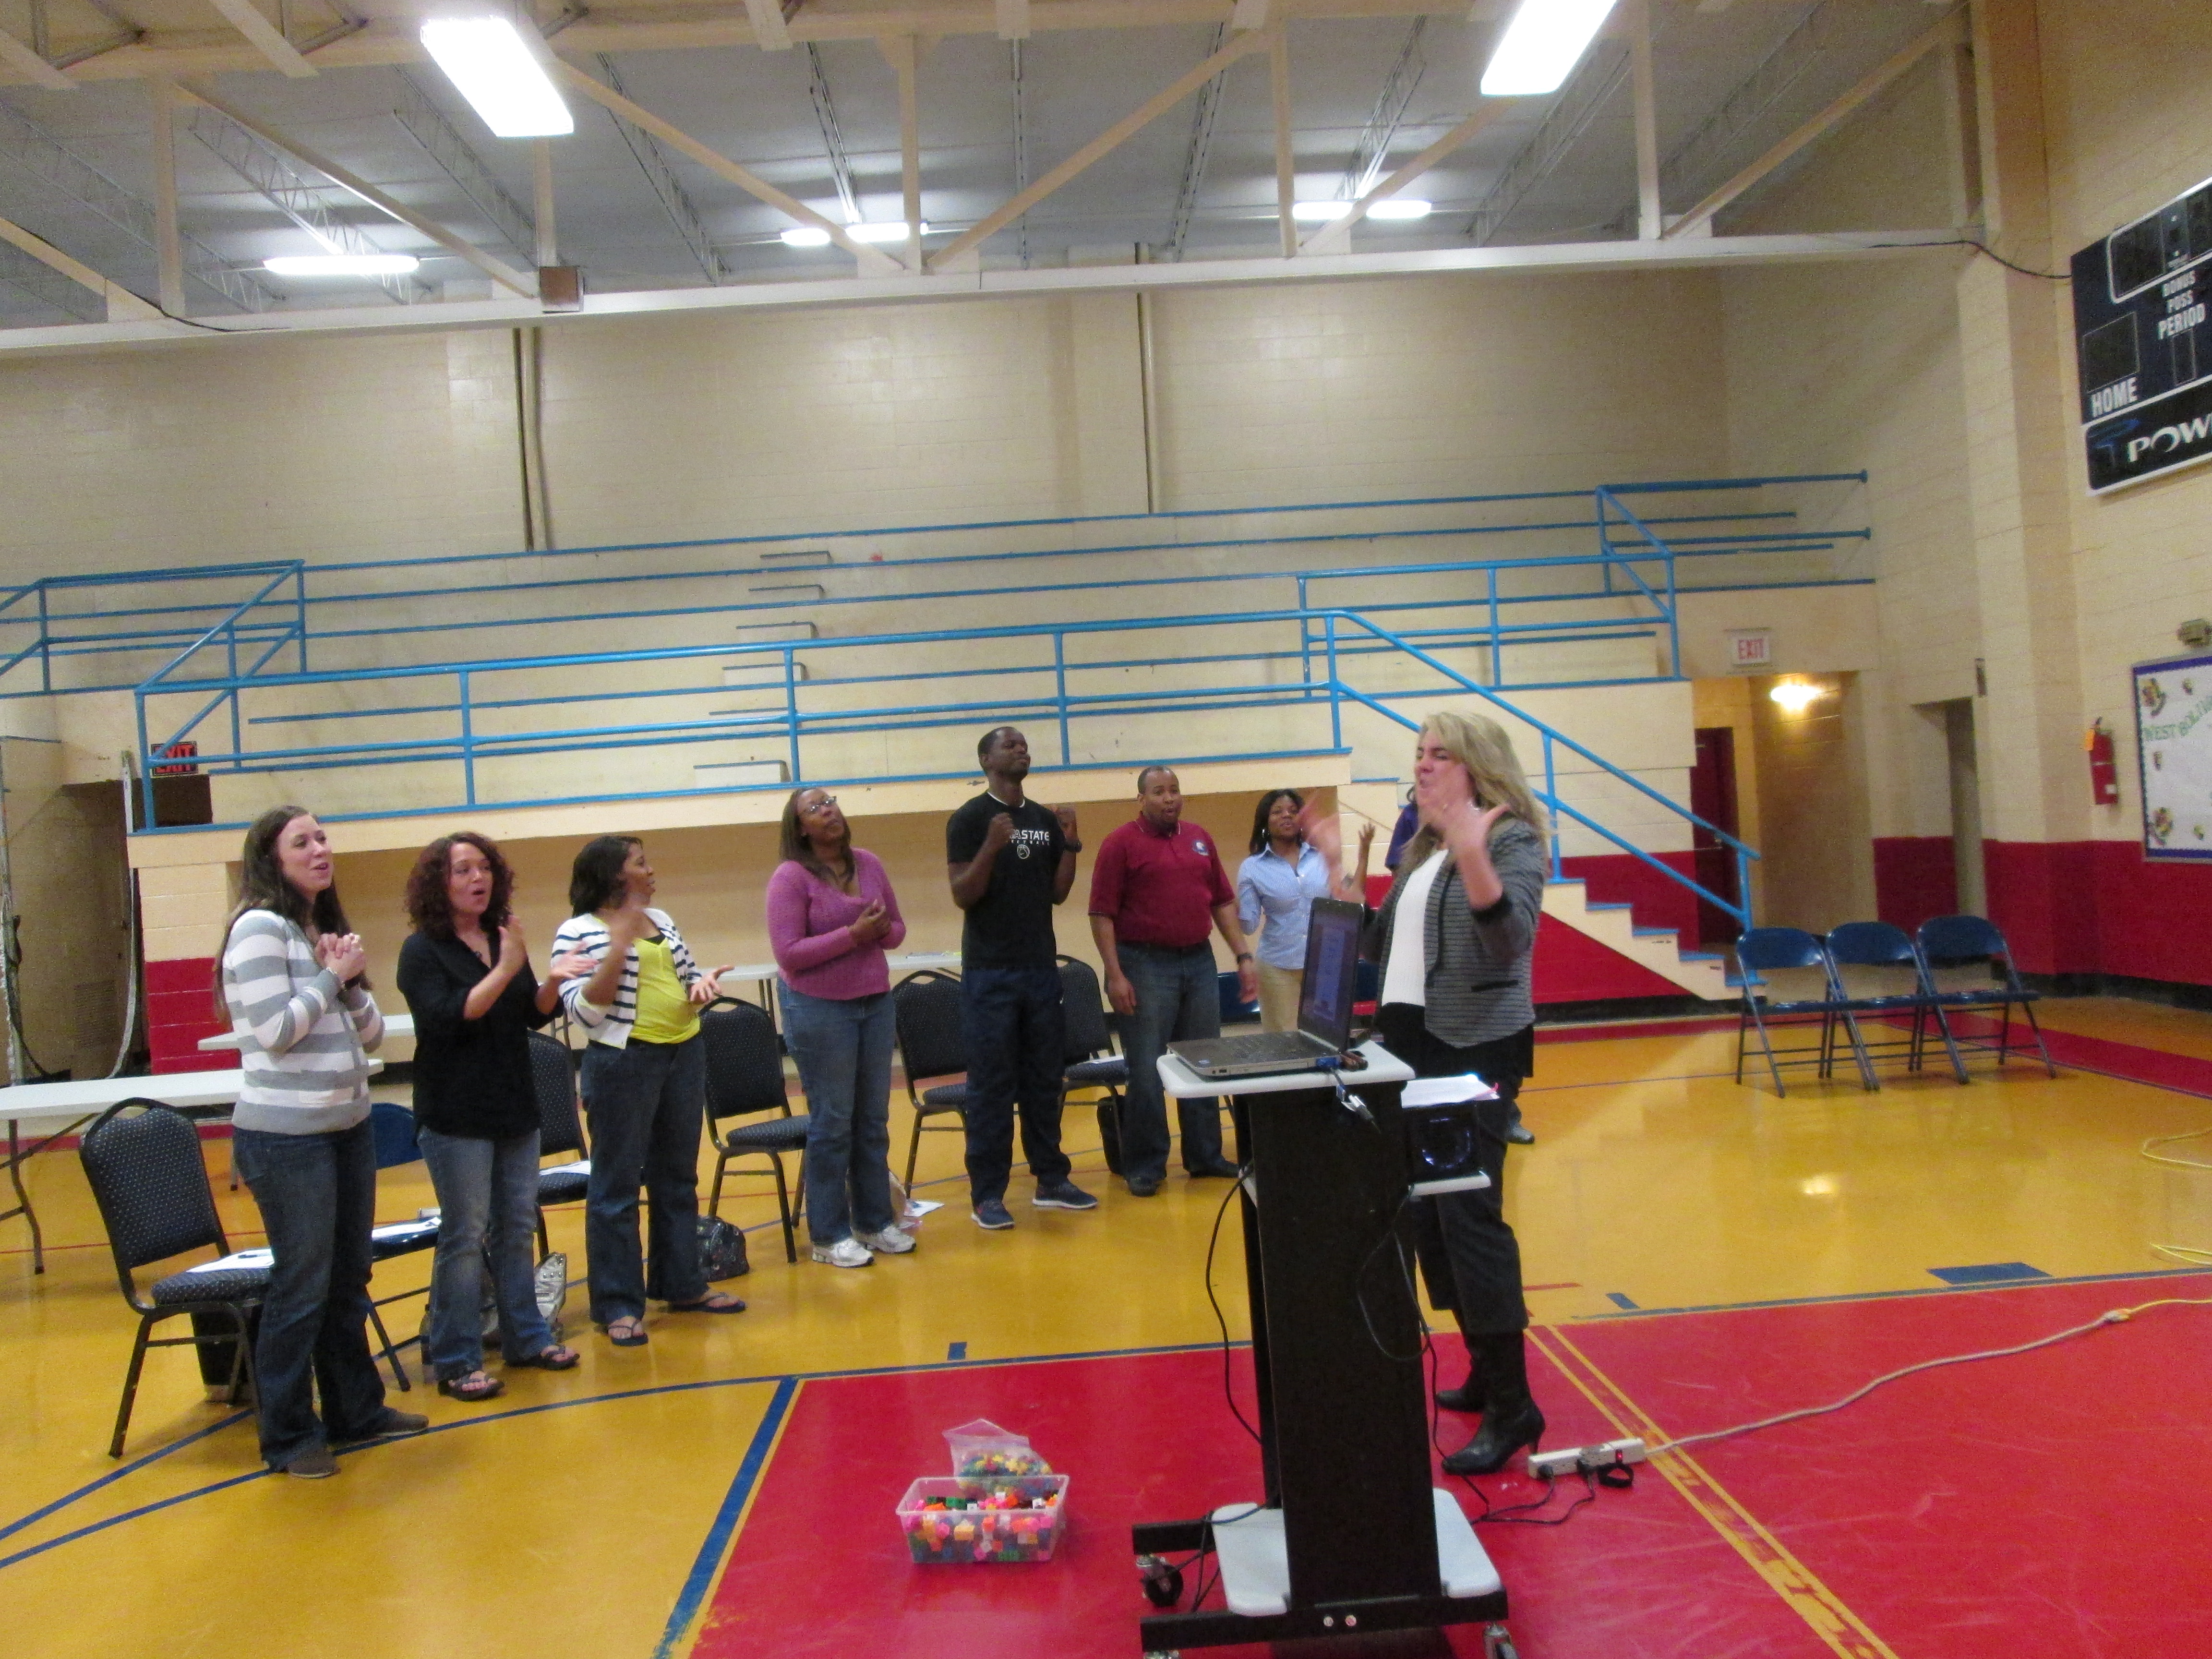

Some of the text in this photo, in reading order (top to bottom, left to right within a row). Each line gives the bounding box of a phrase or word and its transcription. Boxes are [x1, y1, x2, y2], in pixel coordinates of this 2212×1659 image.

[2158, 302, 2205, 340] PERIOD
[2091, 377, 2138, 417] HOME
[2128, 412, 2212, 462] POW
[1738, 638, 1764, 660] EXIT
